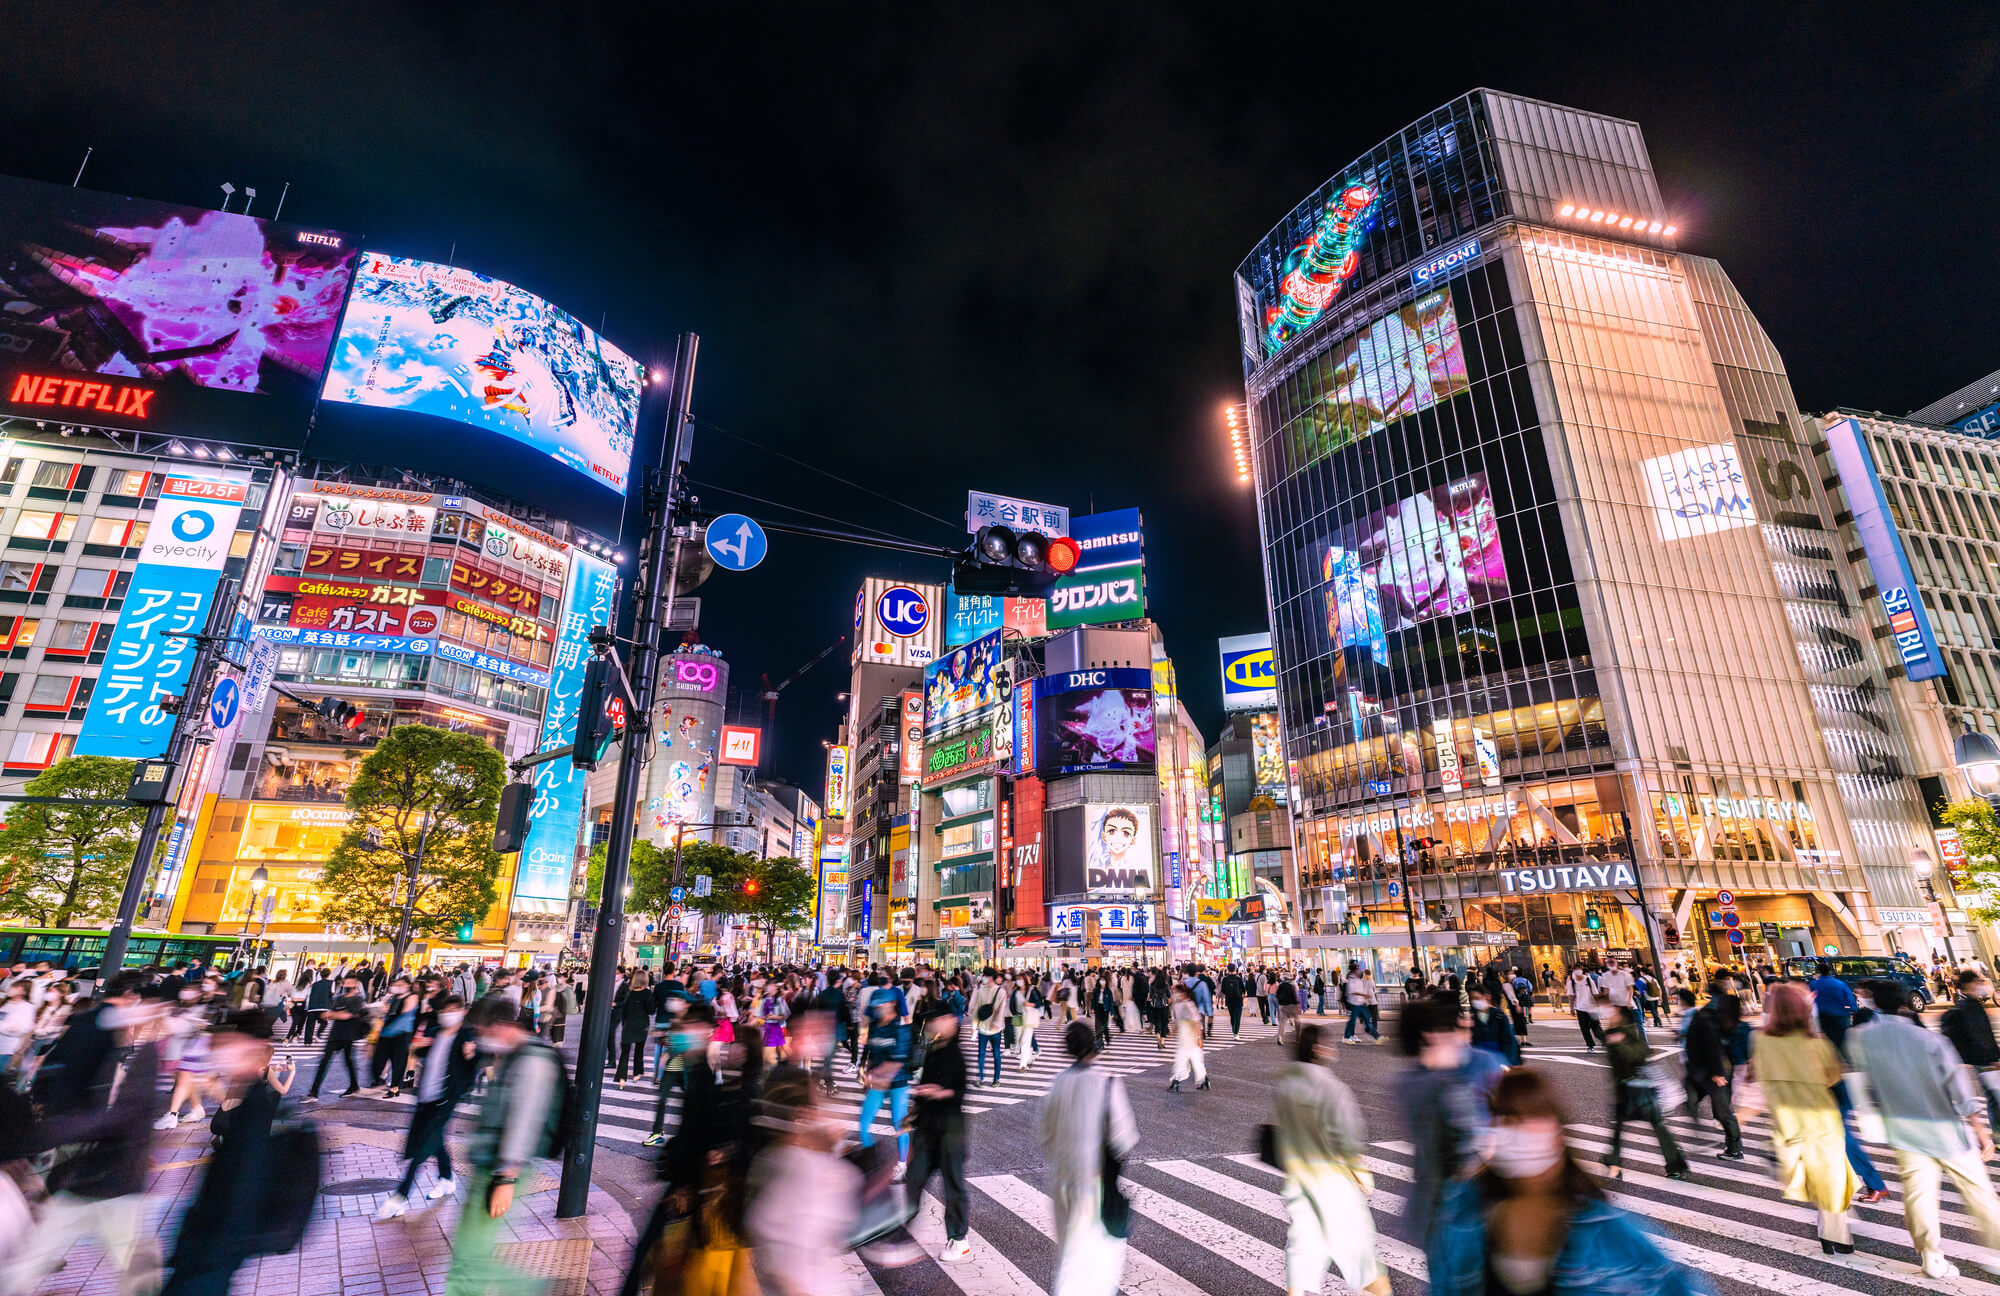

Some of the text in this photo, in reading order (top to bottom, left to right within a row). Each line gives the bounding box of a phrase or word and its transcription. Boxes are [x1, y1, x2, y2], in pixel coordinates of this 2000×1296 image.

[298, 231, 341, 248] NETFLIX
[1417, 294, 1442, 310] NETFLIX
[11, 374, 154, 418] NETFLIX
[1963, 411, 1998, 438] SE
[592, 463, 621, 486] NETFLIX
[171, 481, 239, 498] 当ビル5F
[312, 481, 433, 504] しゃぶしゃぶバイキング
[1449, 478, 1477, 496] NETFLIX
[291, 506, 316, 519] 9F
[358, 509, 426, 532] しゃぶ葉
[977, 497, 1061, 530] 渋谷駅前
[482, 506, 569, 551] しゃぶしゃぶバイキング
[1075, 531, 1139, 550] samitsu
[152, 544, 218, 562] eyecity
[308, 549, 420, 576] プライス
[512, 543, 564, 577] しゃぶ葉
[370, 585, 425, 606] ガスト
[451, 563, 537, 608] コンタクト
[1051, 578, 1137, 613] サロンパス
[263, 603, 291, 619] 7F
[297, 606, 328, 618] Café
[328, 606, 400, 633] ガスト
[883, 597, 925, 625] UC
[257, 628, 294, 641] AEON
[412, 620, 434, 629] ガスト
[509, 616, 549, 641] ガスト
[1881, 586, 1929, 665] SEIBU
[303, 631, 406, 650] 英会話イーオン
[412, 640, 427, 650] 6F
[103, 588, 173, 724] アイシティ
[139, 591, 203, 726] コンタクトの
[442, 644, 472, 662] AEON
[909, 648, 932, 659] VISA
[475, 653, 551, 688] 英会話イーオン
[676, 660, 718, 692] 109
[1069, 671, 1106, 688] DHC
[1234, 659, 1276, 680] IK
[676, 682, 702, 691] SHIBUYA
[529, 609, 588, 819] 再開しませんか
[994, 663, 1013, 755] もんじゃ
[1020, 686, 1031, 766] 三千里薬品
[1443, 801, 1518, 823] COFFEE
[1700, 797, 1816, 822] TSUTAYA
[541, 851, 566, 863] pairs
[1942, 840, 1964, 855] 本
[1088, 868, 1151, 889] DMM
[1500, 864, 1636, 892] TSUTAYA
[1056, 909, 1148, 929] 大盛書店
[1880, 911, 1925, 922] TSUTAYA
